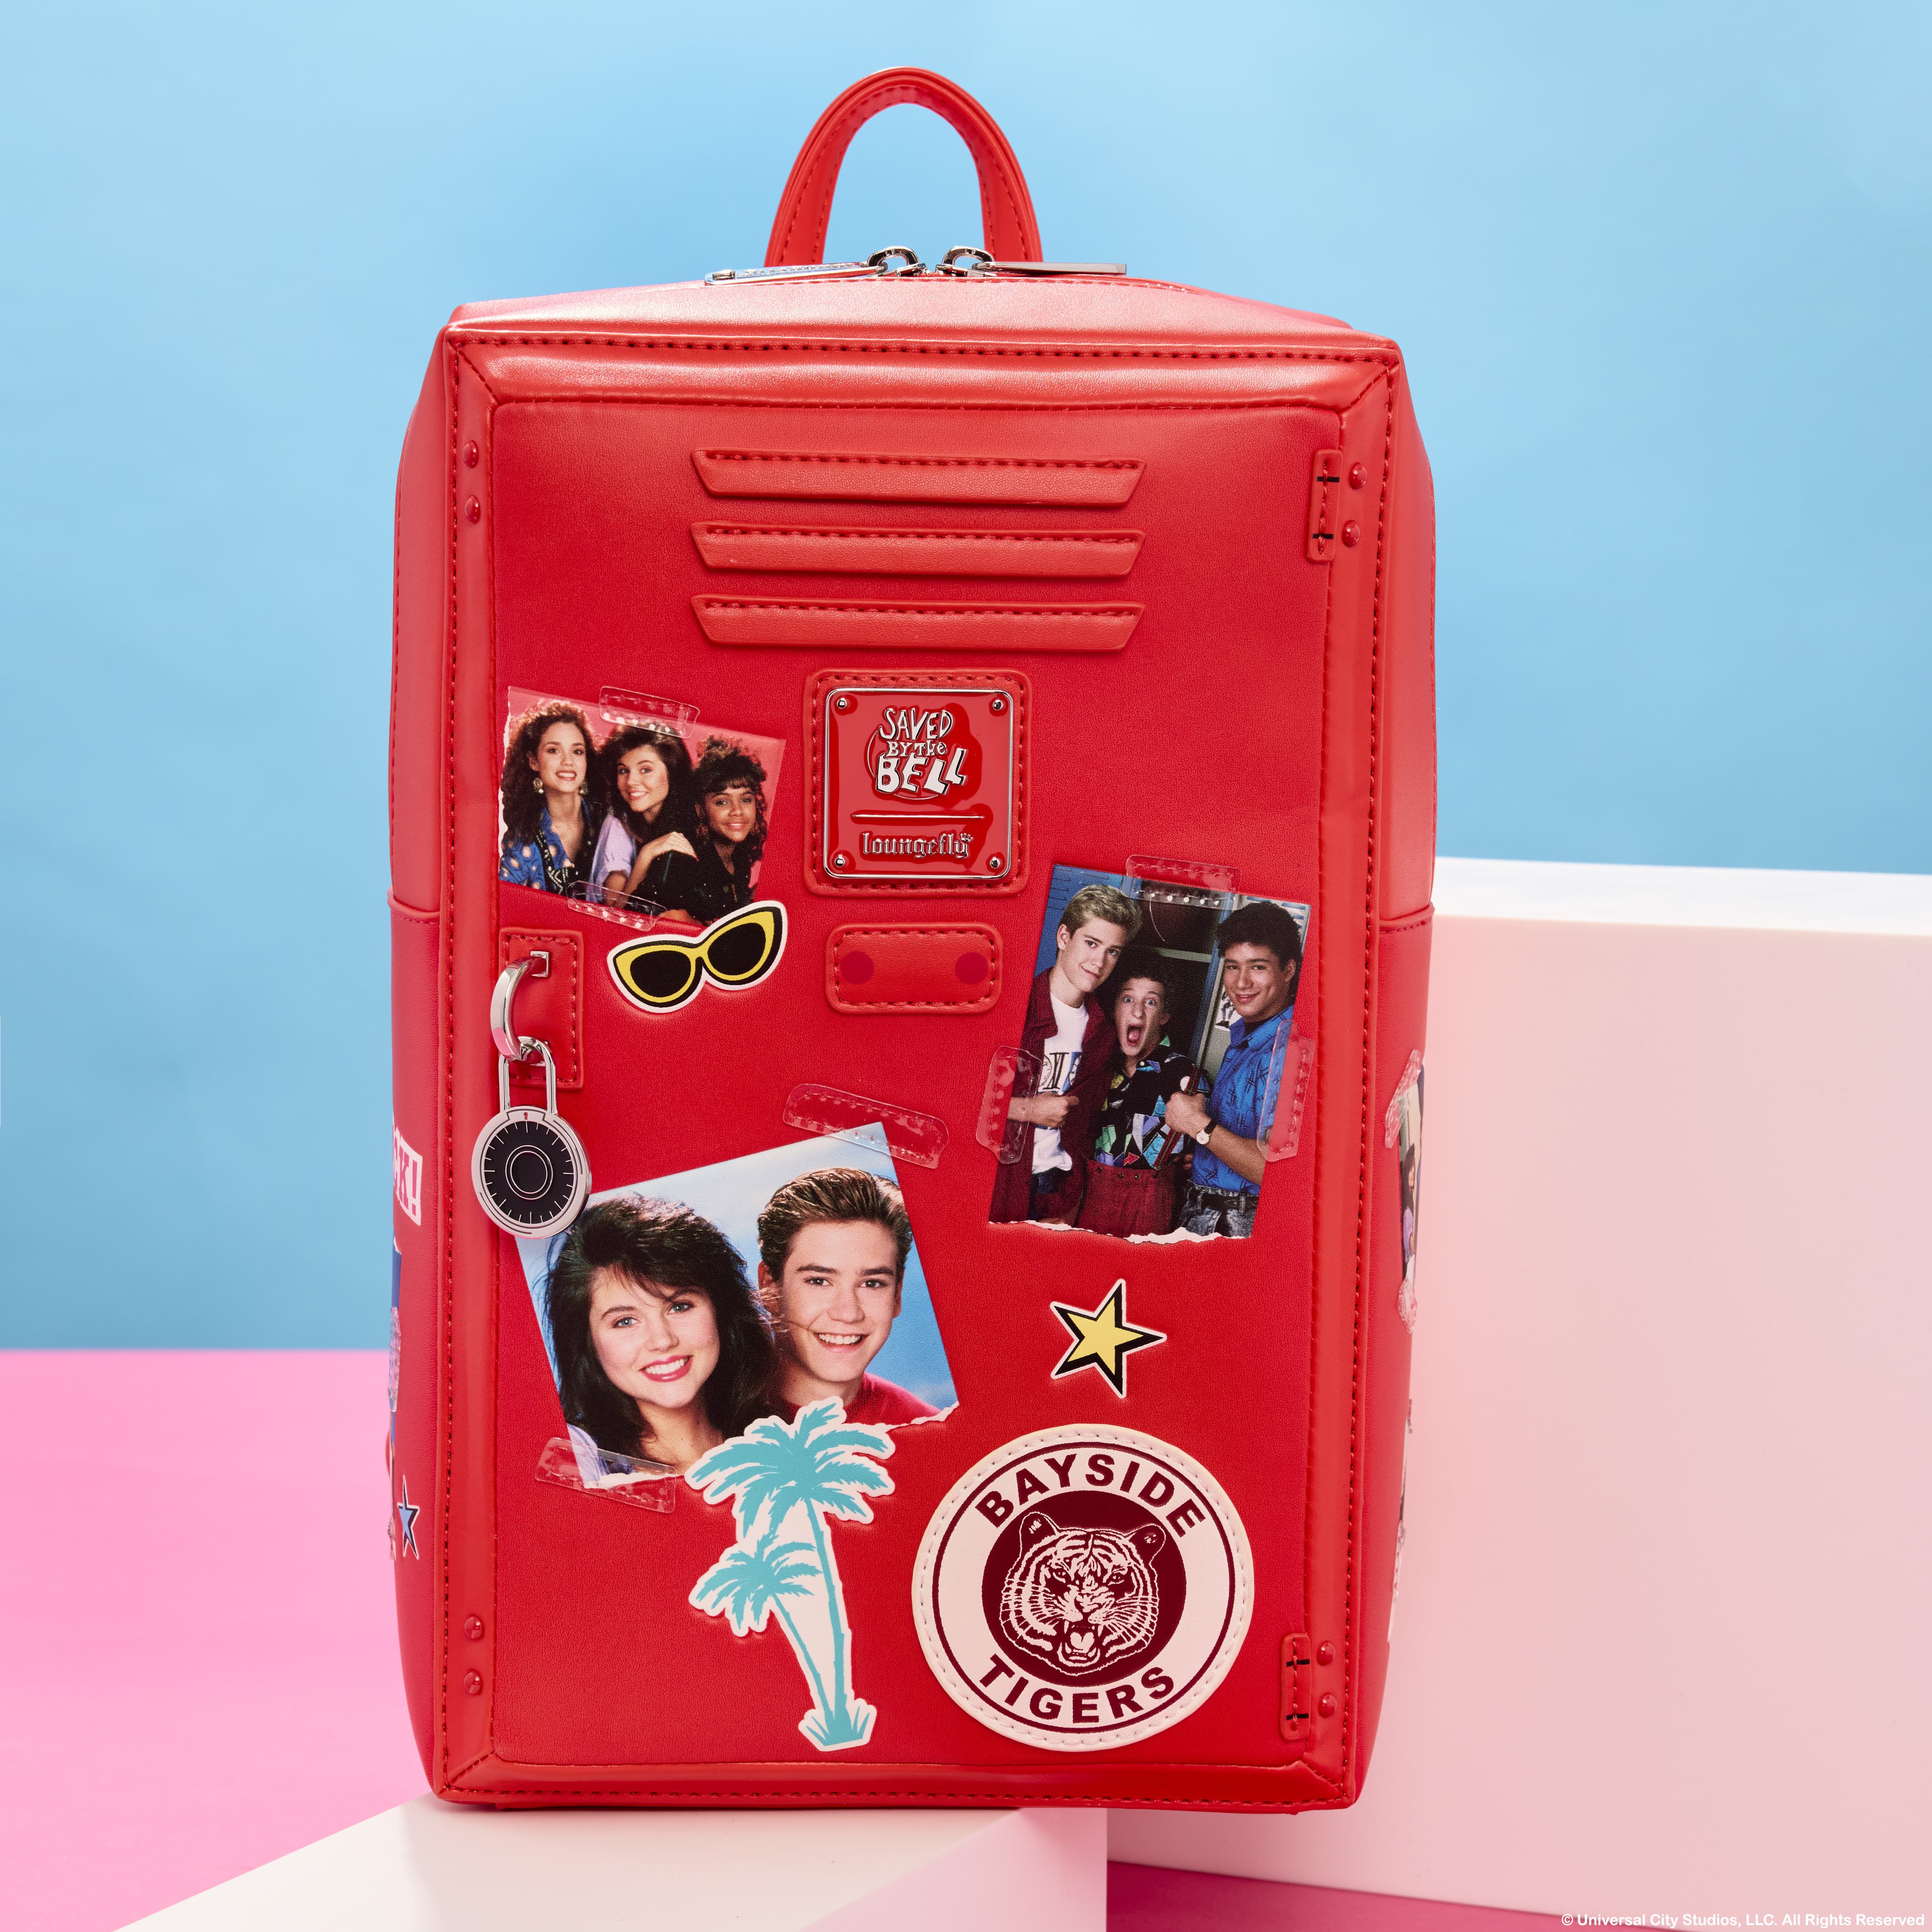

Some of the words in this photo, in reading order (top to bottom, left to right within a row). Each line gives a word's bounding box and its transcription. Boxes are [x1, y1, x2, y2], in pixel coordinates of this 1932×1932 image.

[879, 708, 954, 740] SAVED
[886, 741, 912, 757] BY
[875, 748, 967, 795] BELL
[862, 833, 973, 859] loungefly
[975, 1453, 1206, 1537] BAYSIDE
[980, 1653, 1174, 1723] TIGERS
